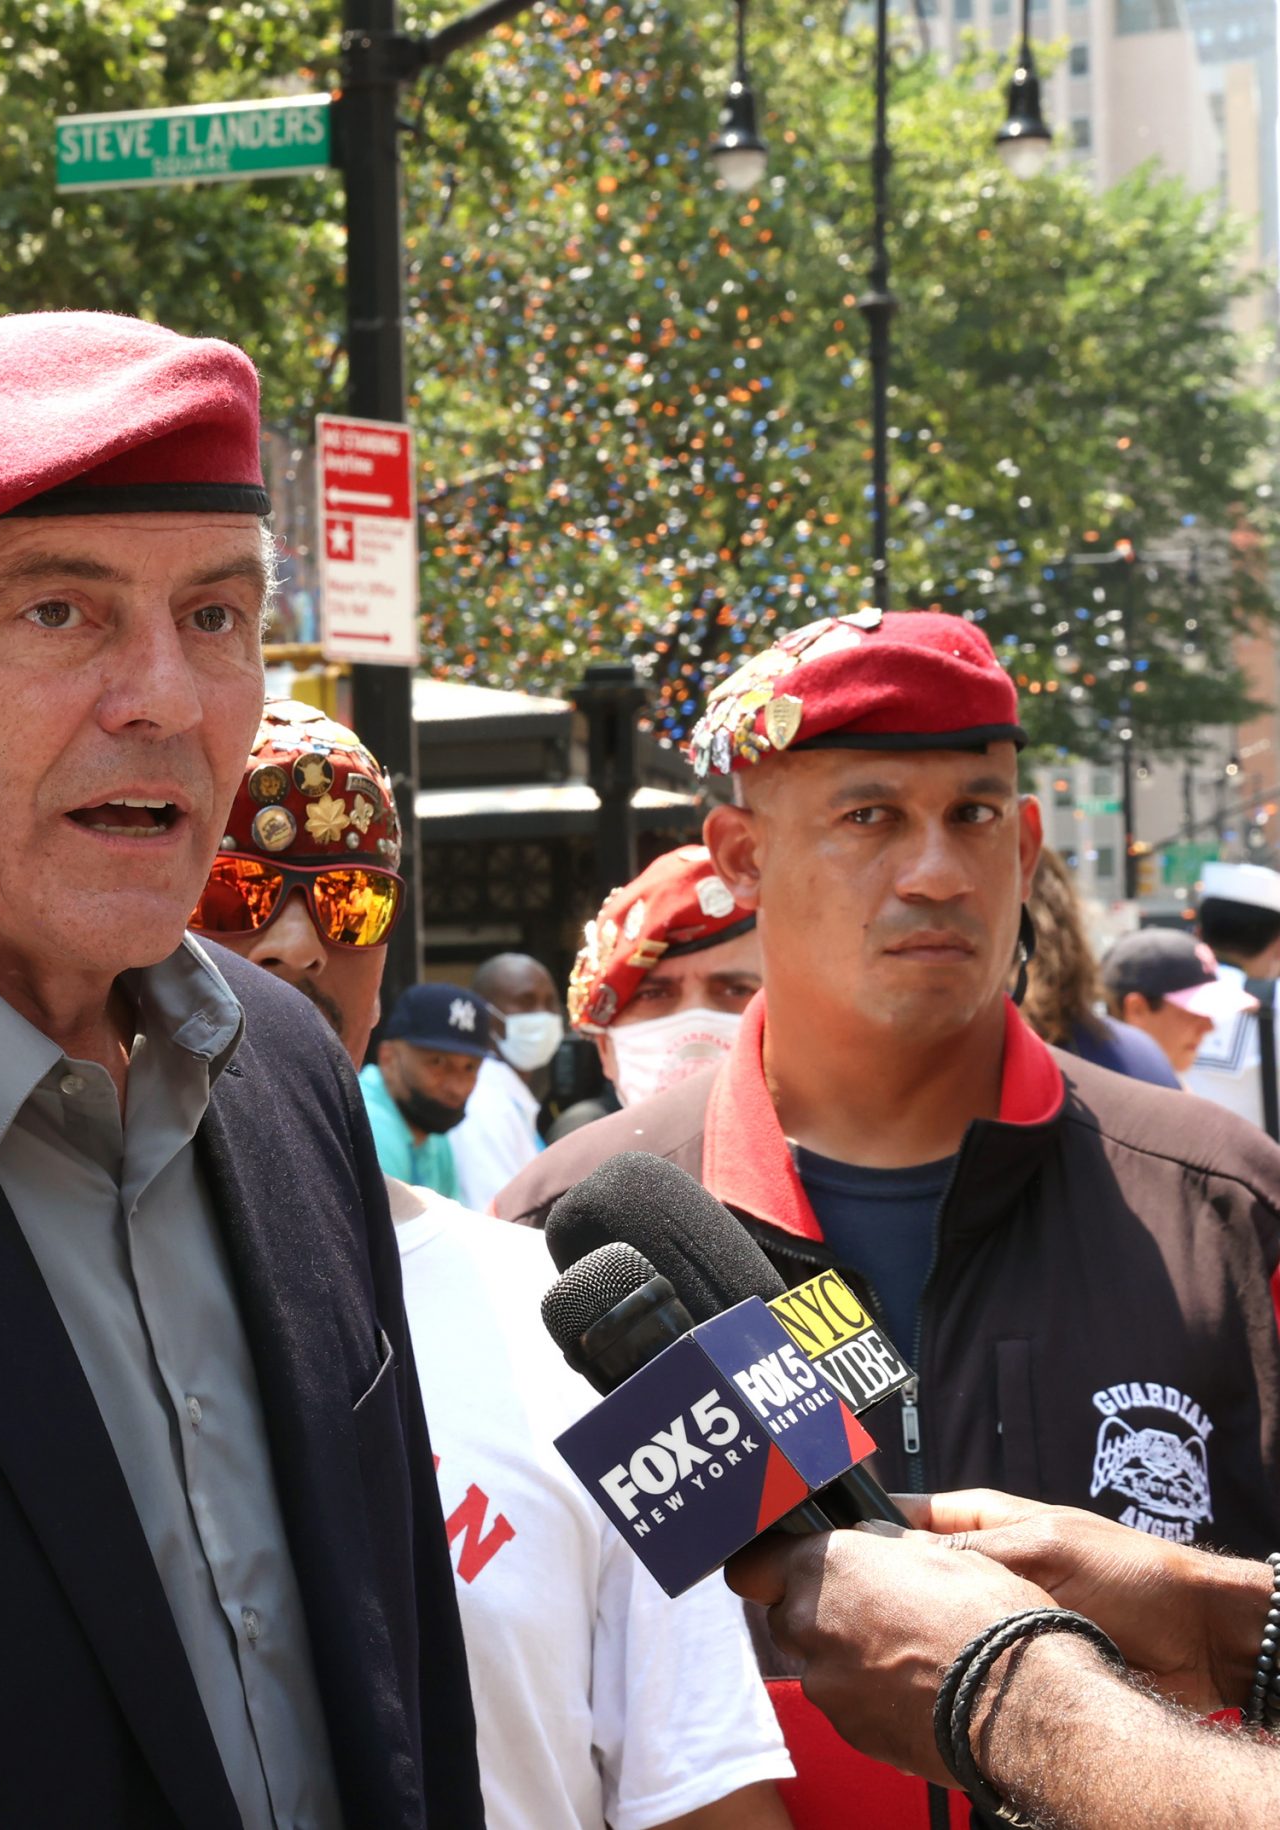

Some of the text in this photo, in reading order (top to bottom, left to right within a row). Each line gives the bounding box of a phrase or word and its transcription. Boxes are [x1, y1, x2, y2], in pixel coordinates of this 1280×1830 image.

[60, 107, 325, 164] STEVE FLANDERS
[769, 1272, 865, 1355] NYC
[812, 1329, 908, 1407] VIBE
[768, 1387, 833, 1434] NEW YORK
[1092, 1382, 1214, 1441] GUARDIAN
[633, 1435, 760, 1537] NEW YORK
[1118, 1505, 1195, 1543] ANGELS
